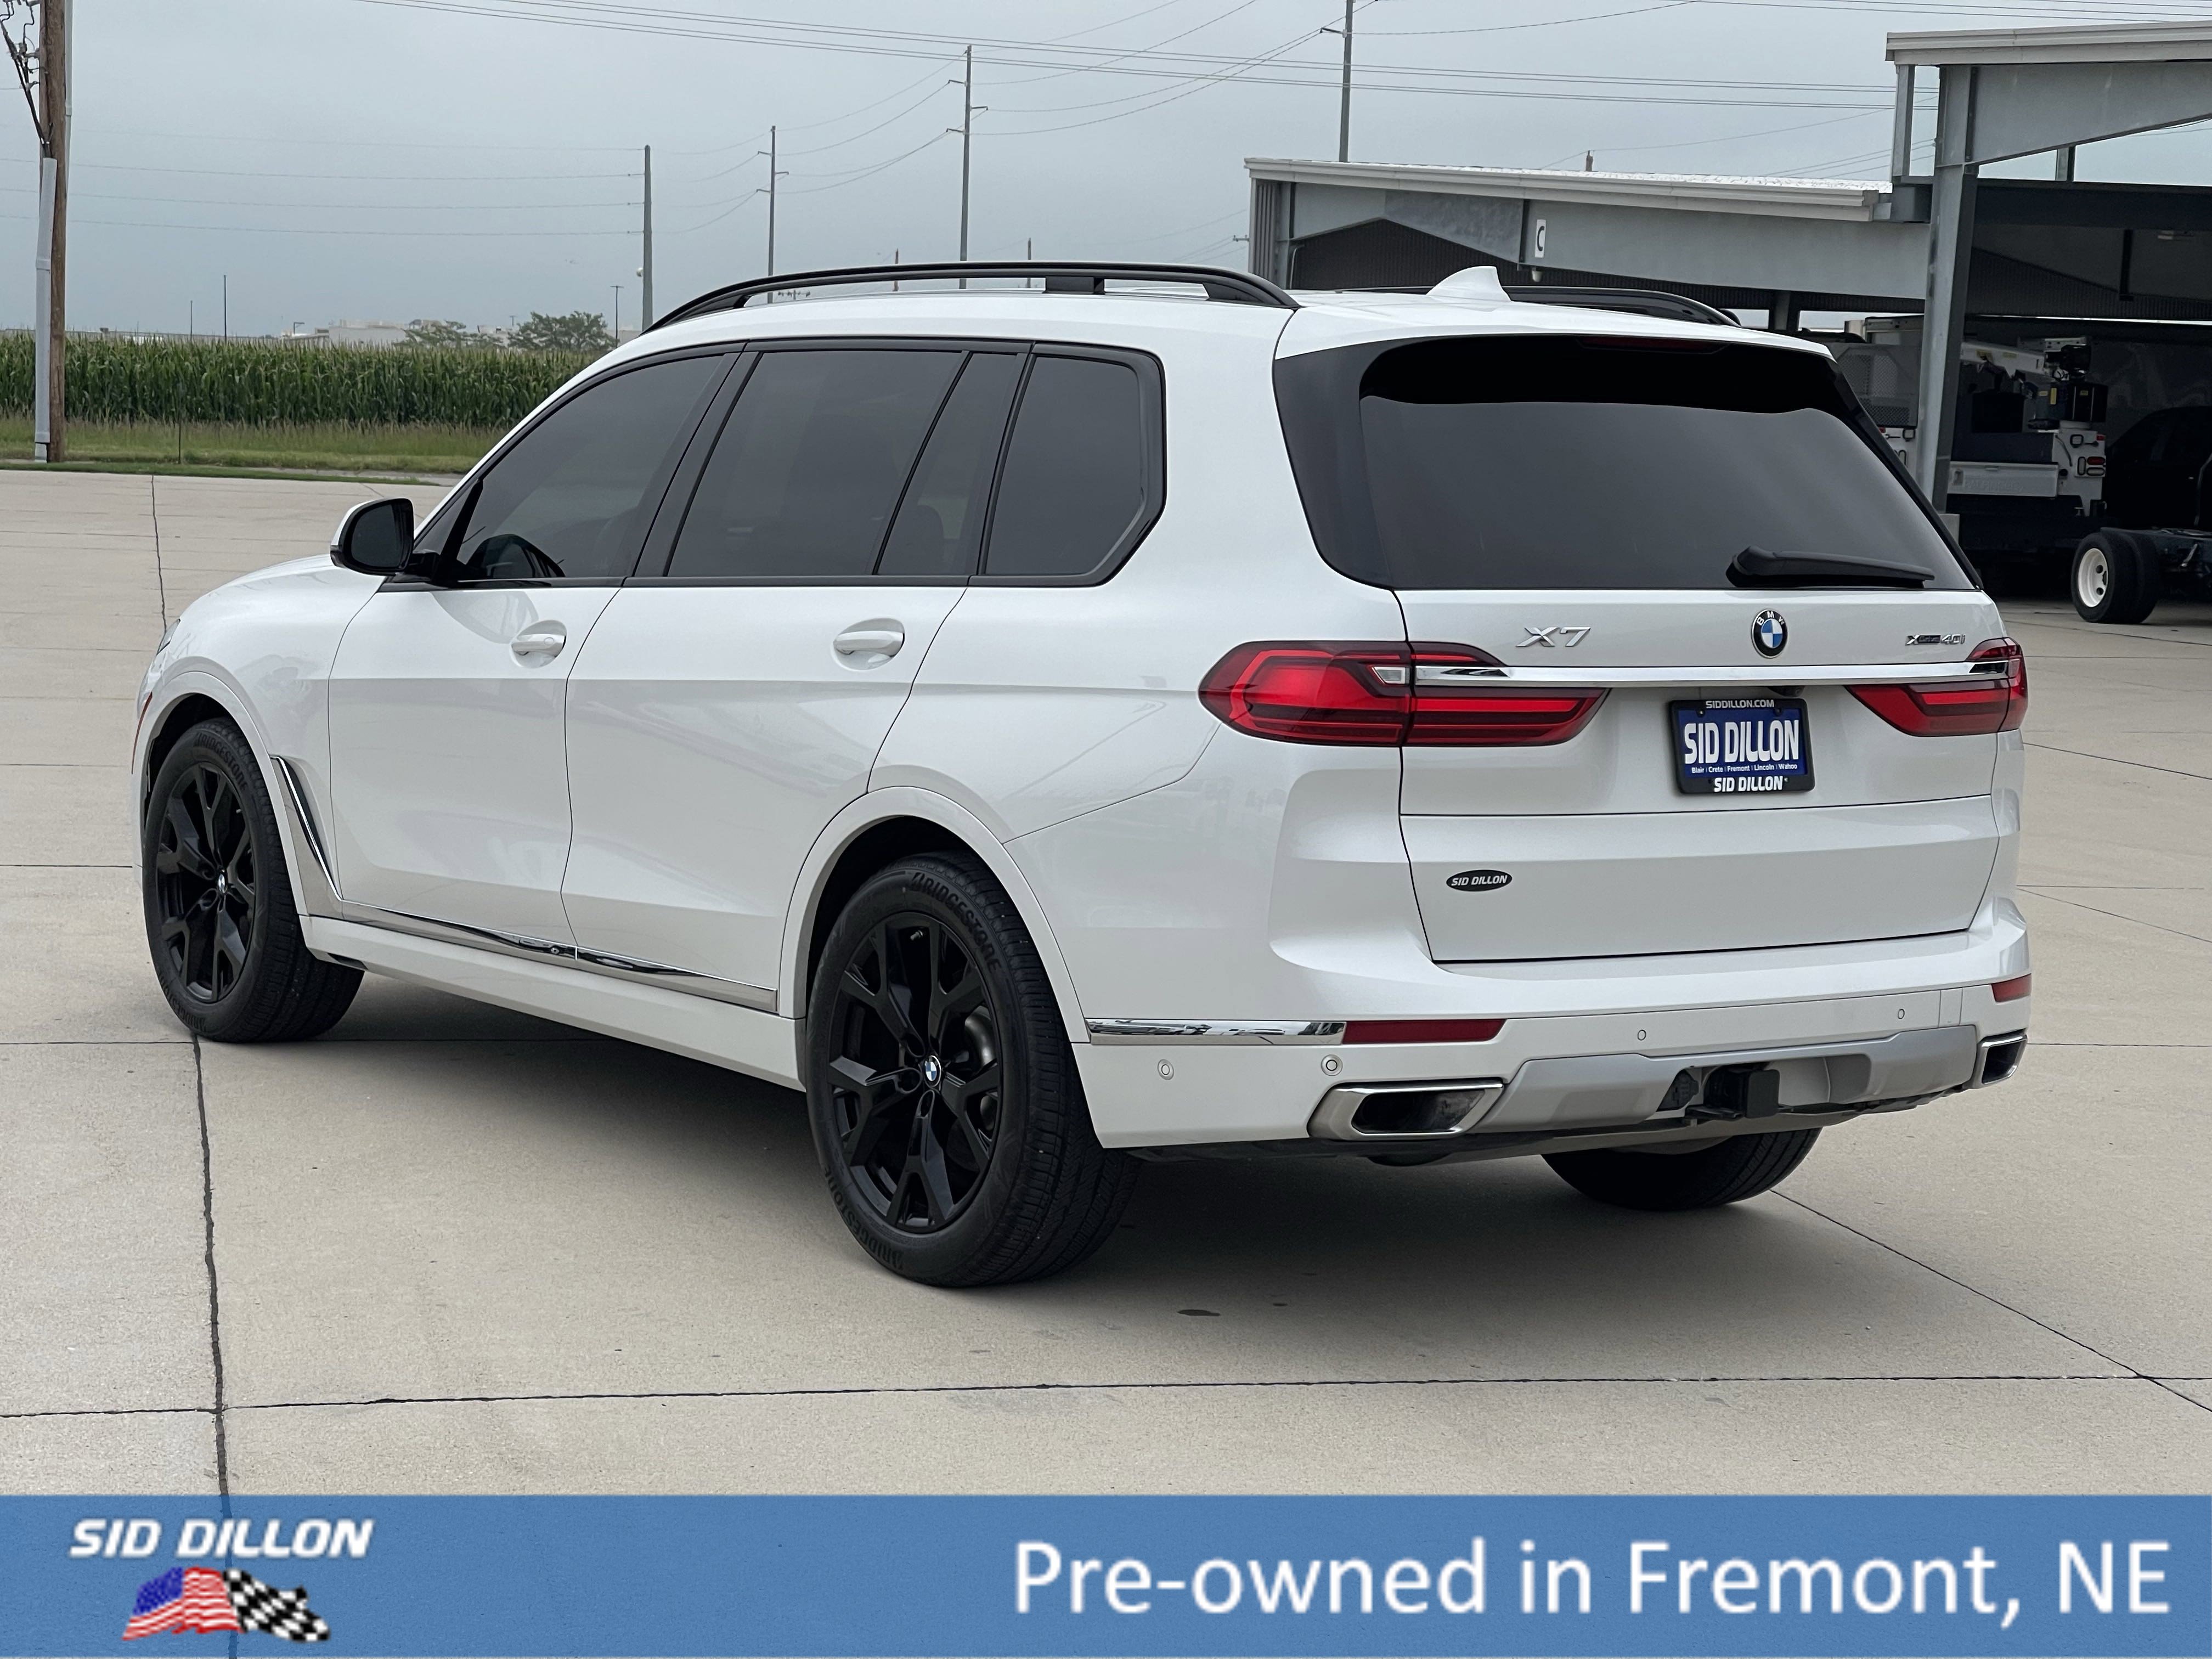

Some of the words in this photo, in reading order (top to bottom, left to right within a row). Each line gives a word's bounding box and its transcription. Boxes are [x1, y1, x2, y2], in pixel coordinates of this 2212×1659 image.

[1537, 225, 1545, 252] C
[1756, 611, 1785, 625] BMW
[1515, 627, 1591, 647] X7
[1706, 699, 1775, 709] SIDDILLON.COM
[1684, 723, 1719, 764] SID
[1724, 720, 1799, 763] DILLON
[1714, 777, 1735, 792] SID
[1738, 776, 1783, 792] DILLON
[1451, 877, 1469, 886] SID
[1471, 875, 1508, 885] DILLON
[912, 872, 1001, 974] BRIDGESTONE
